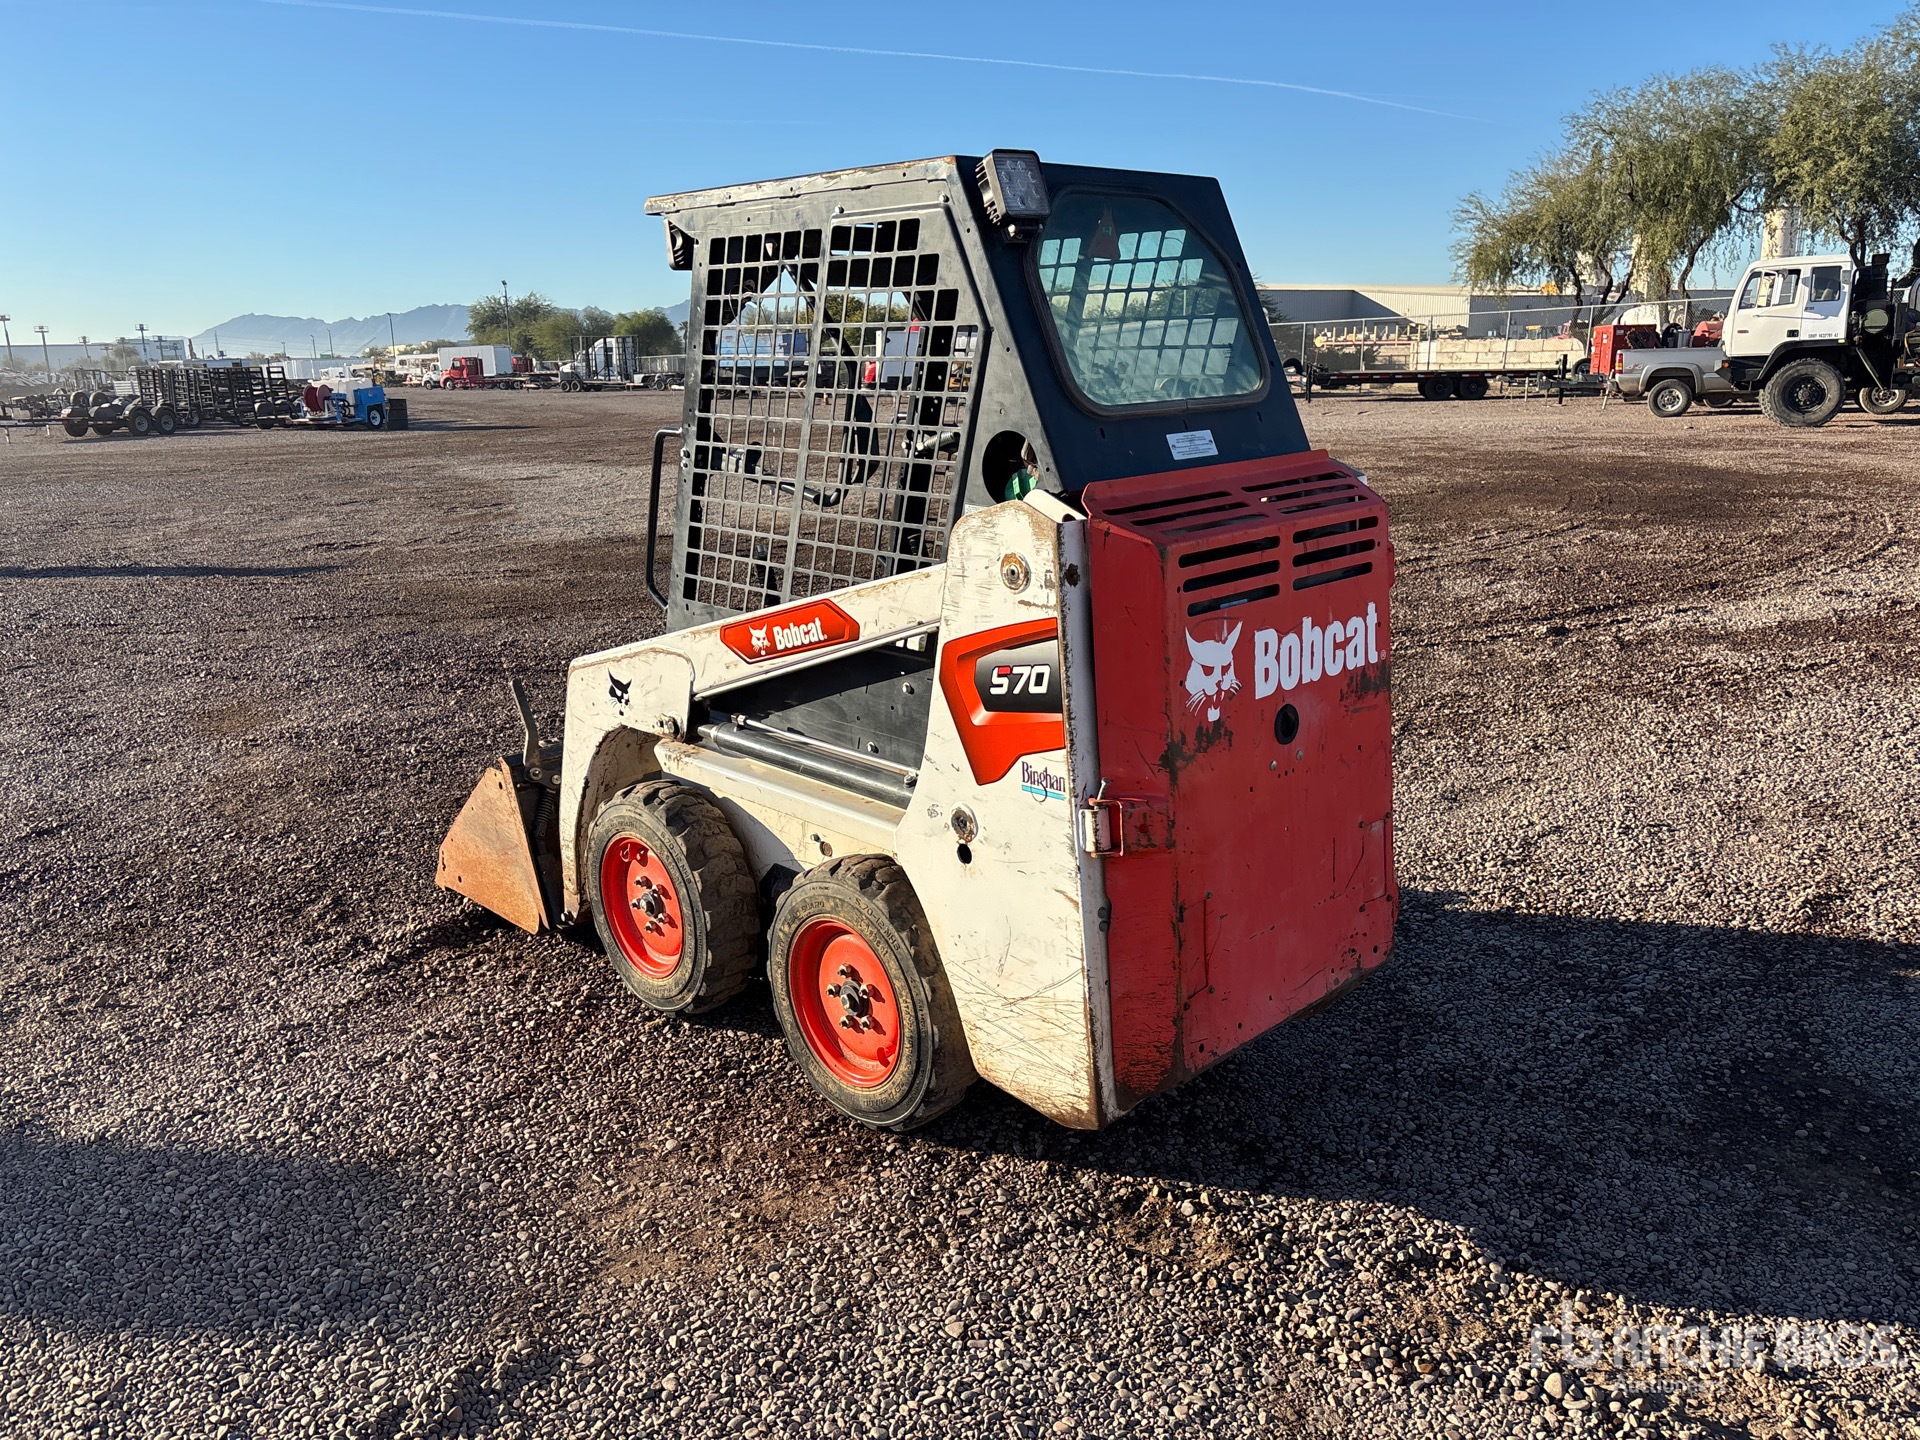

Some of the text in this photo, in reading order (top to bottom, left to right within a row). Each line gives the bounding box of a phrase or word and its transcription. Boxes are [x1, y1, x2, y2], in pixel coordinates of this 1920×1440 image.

[773, 617, 825, 650] Bobcat
[1254, 602, 1379, 700] Bobcat
[989, 664, 1051, 695] S70
